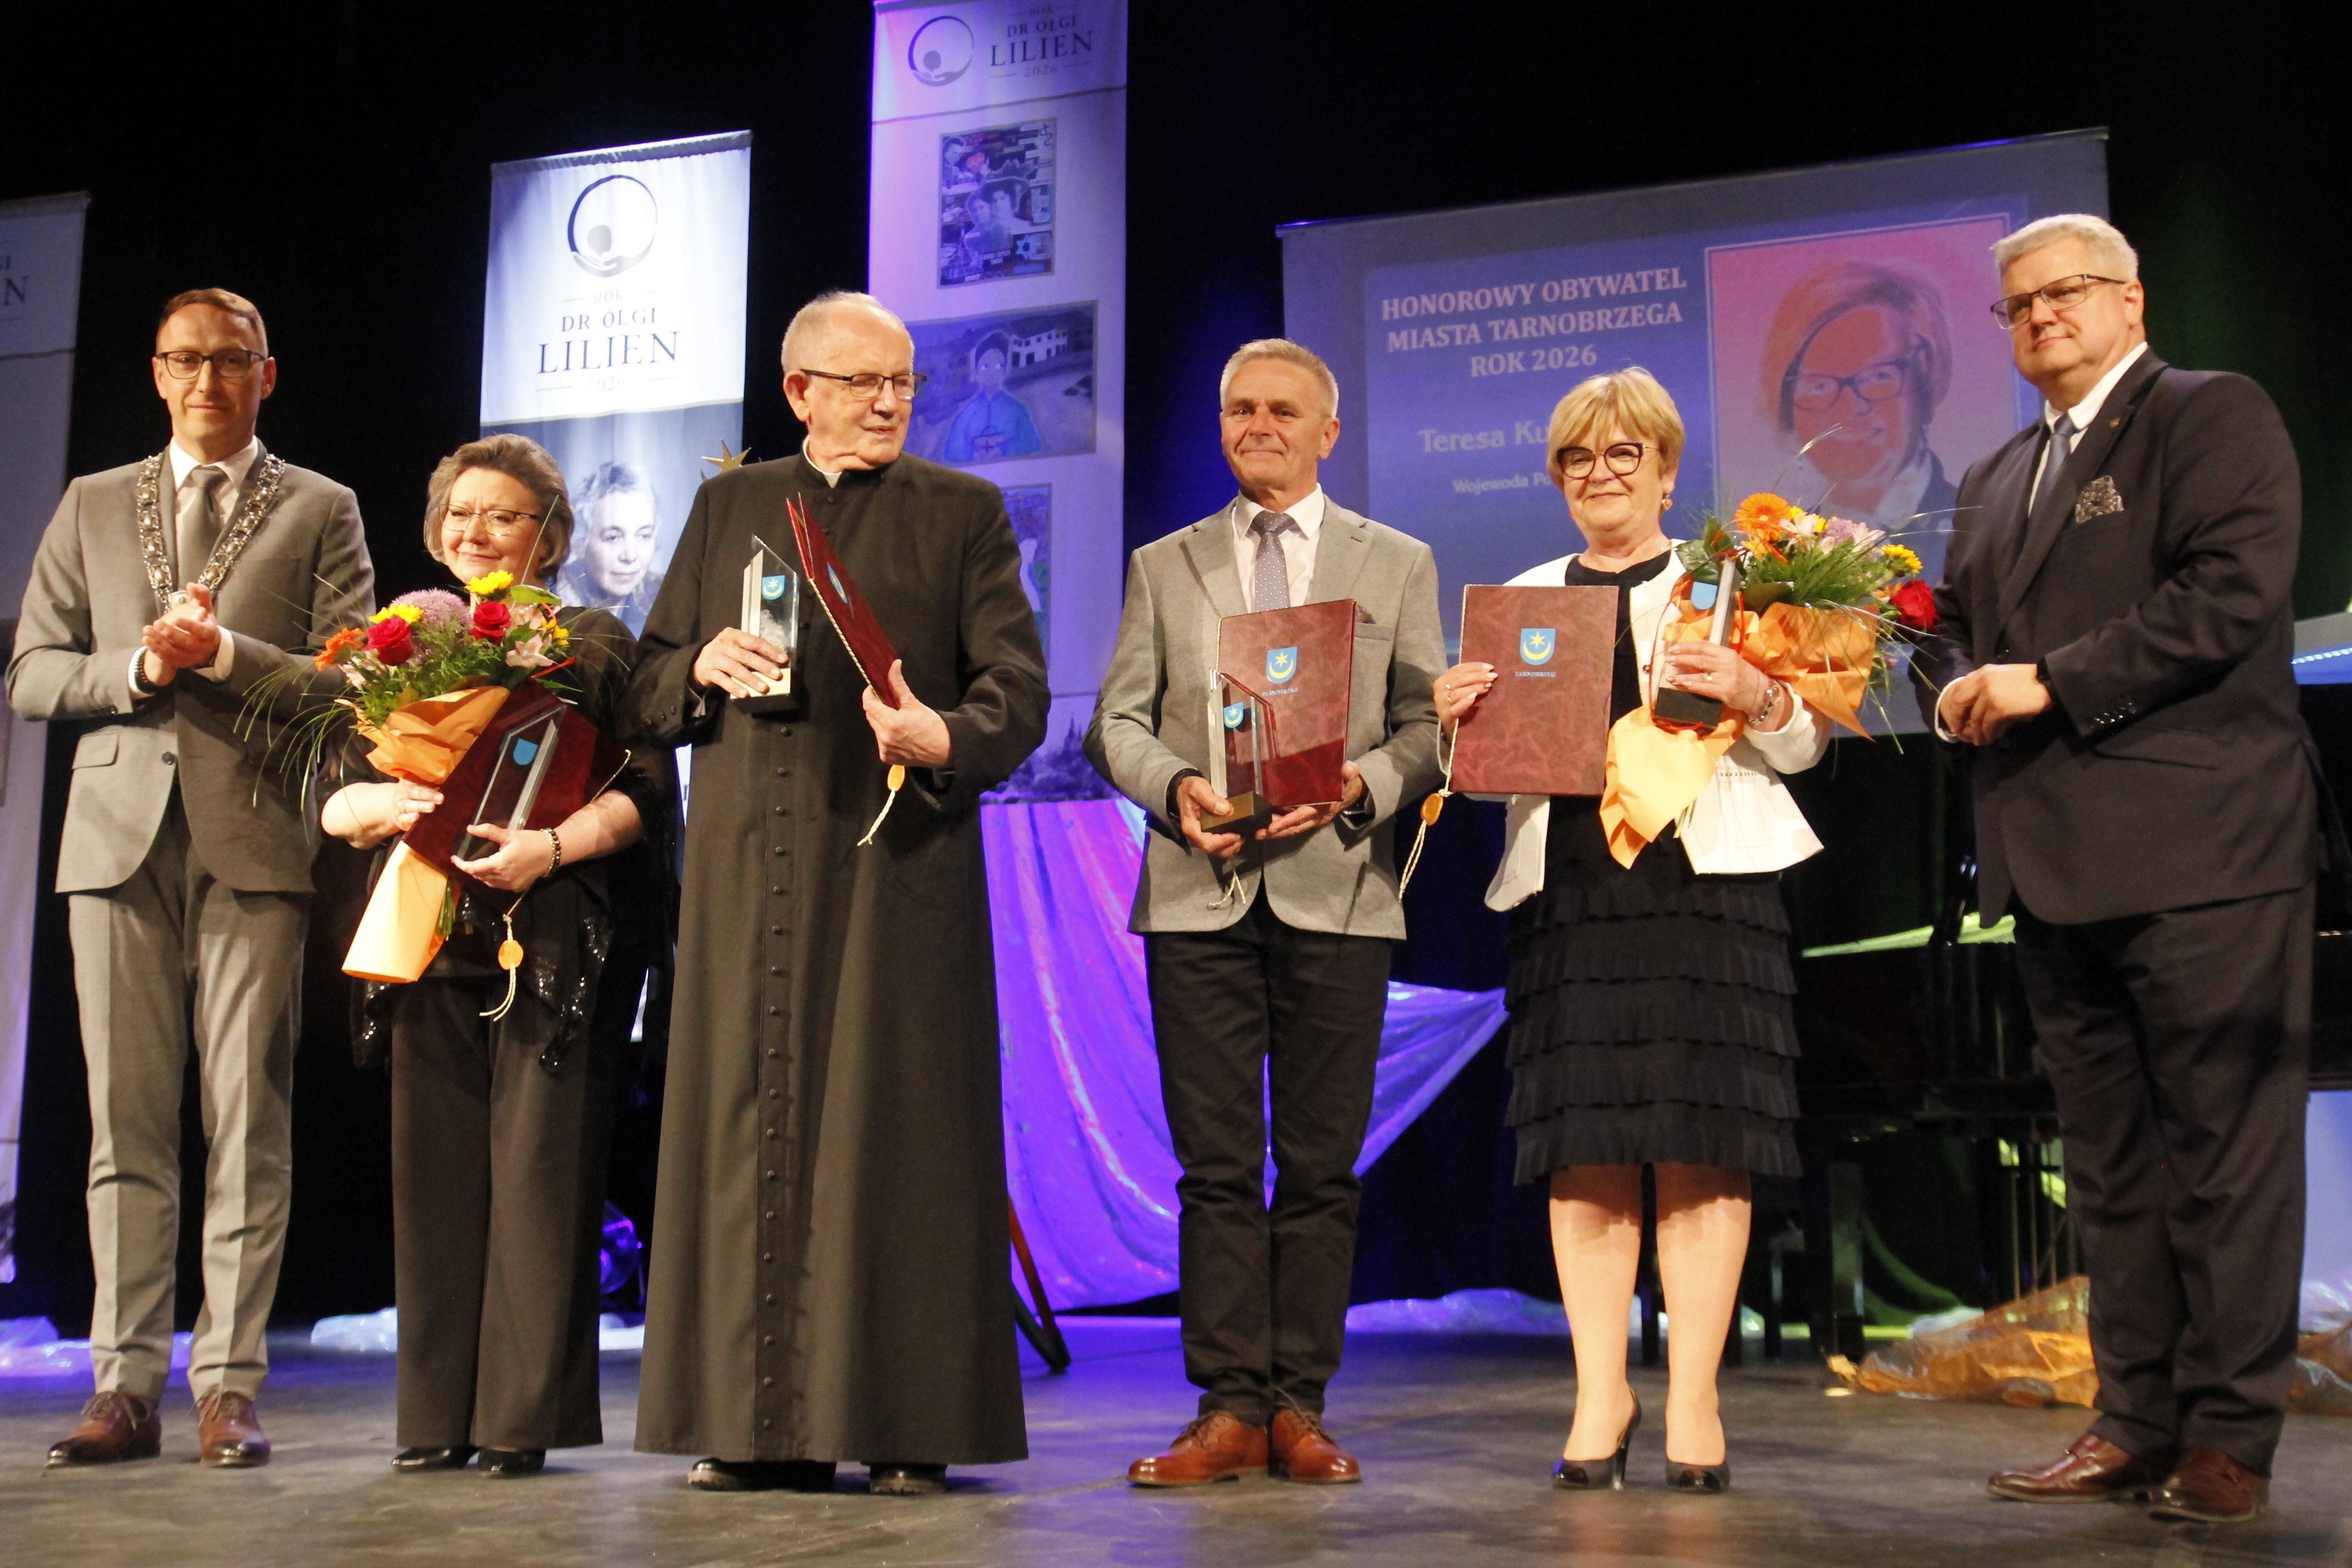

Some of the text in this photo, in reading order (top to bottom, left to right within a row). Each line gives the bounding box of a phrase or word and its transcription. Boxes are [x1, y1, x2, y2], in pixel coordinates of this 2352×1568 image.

[1007, 15, 1077, 37] DR OLGI
[990, 30, 1093, 66] LILIEN
[594, 289, 624, 304] ROK
[1382, 268, 1687, 321] HONOROWY OBYWATEL
[561, 307, 657, 333] DR OLGI
[1387, 302, 1682, 353] MIASTA TARNOBRZEGA
[537, 331, 680, 375] LILIEN
[1471, 344, 1597, 377] ROK 2026
[584, 375, 626, 393] 2026
[1418, 420, 1549, 452] Teresa Ku
[1454, 475, 1529, 495] Wojewoda
